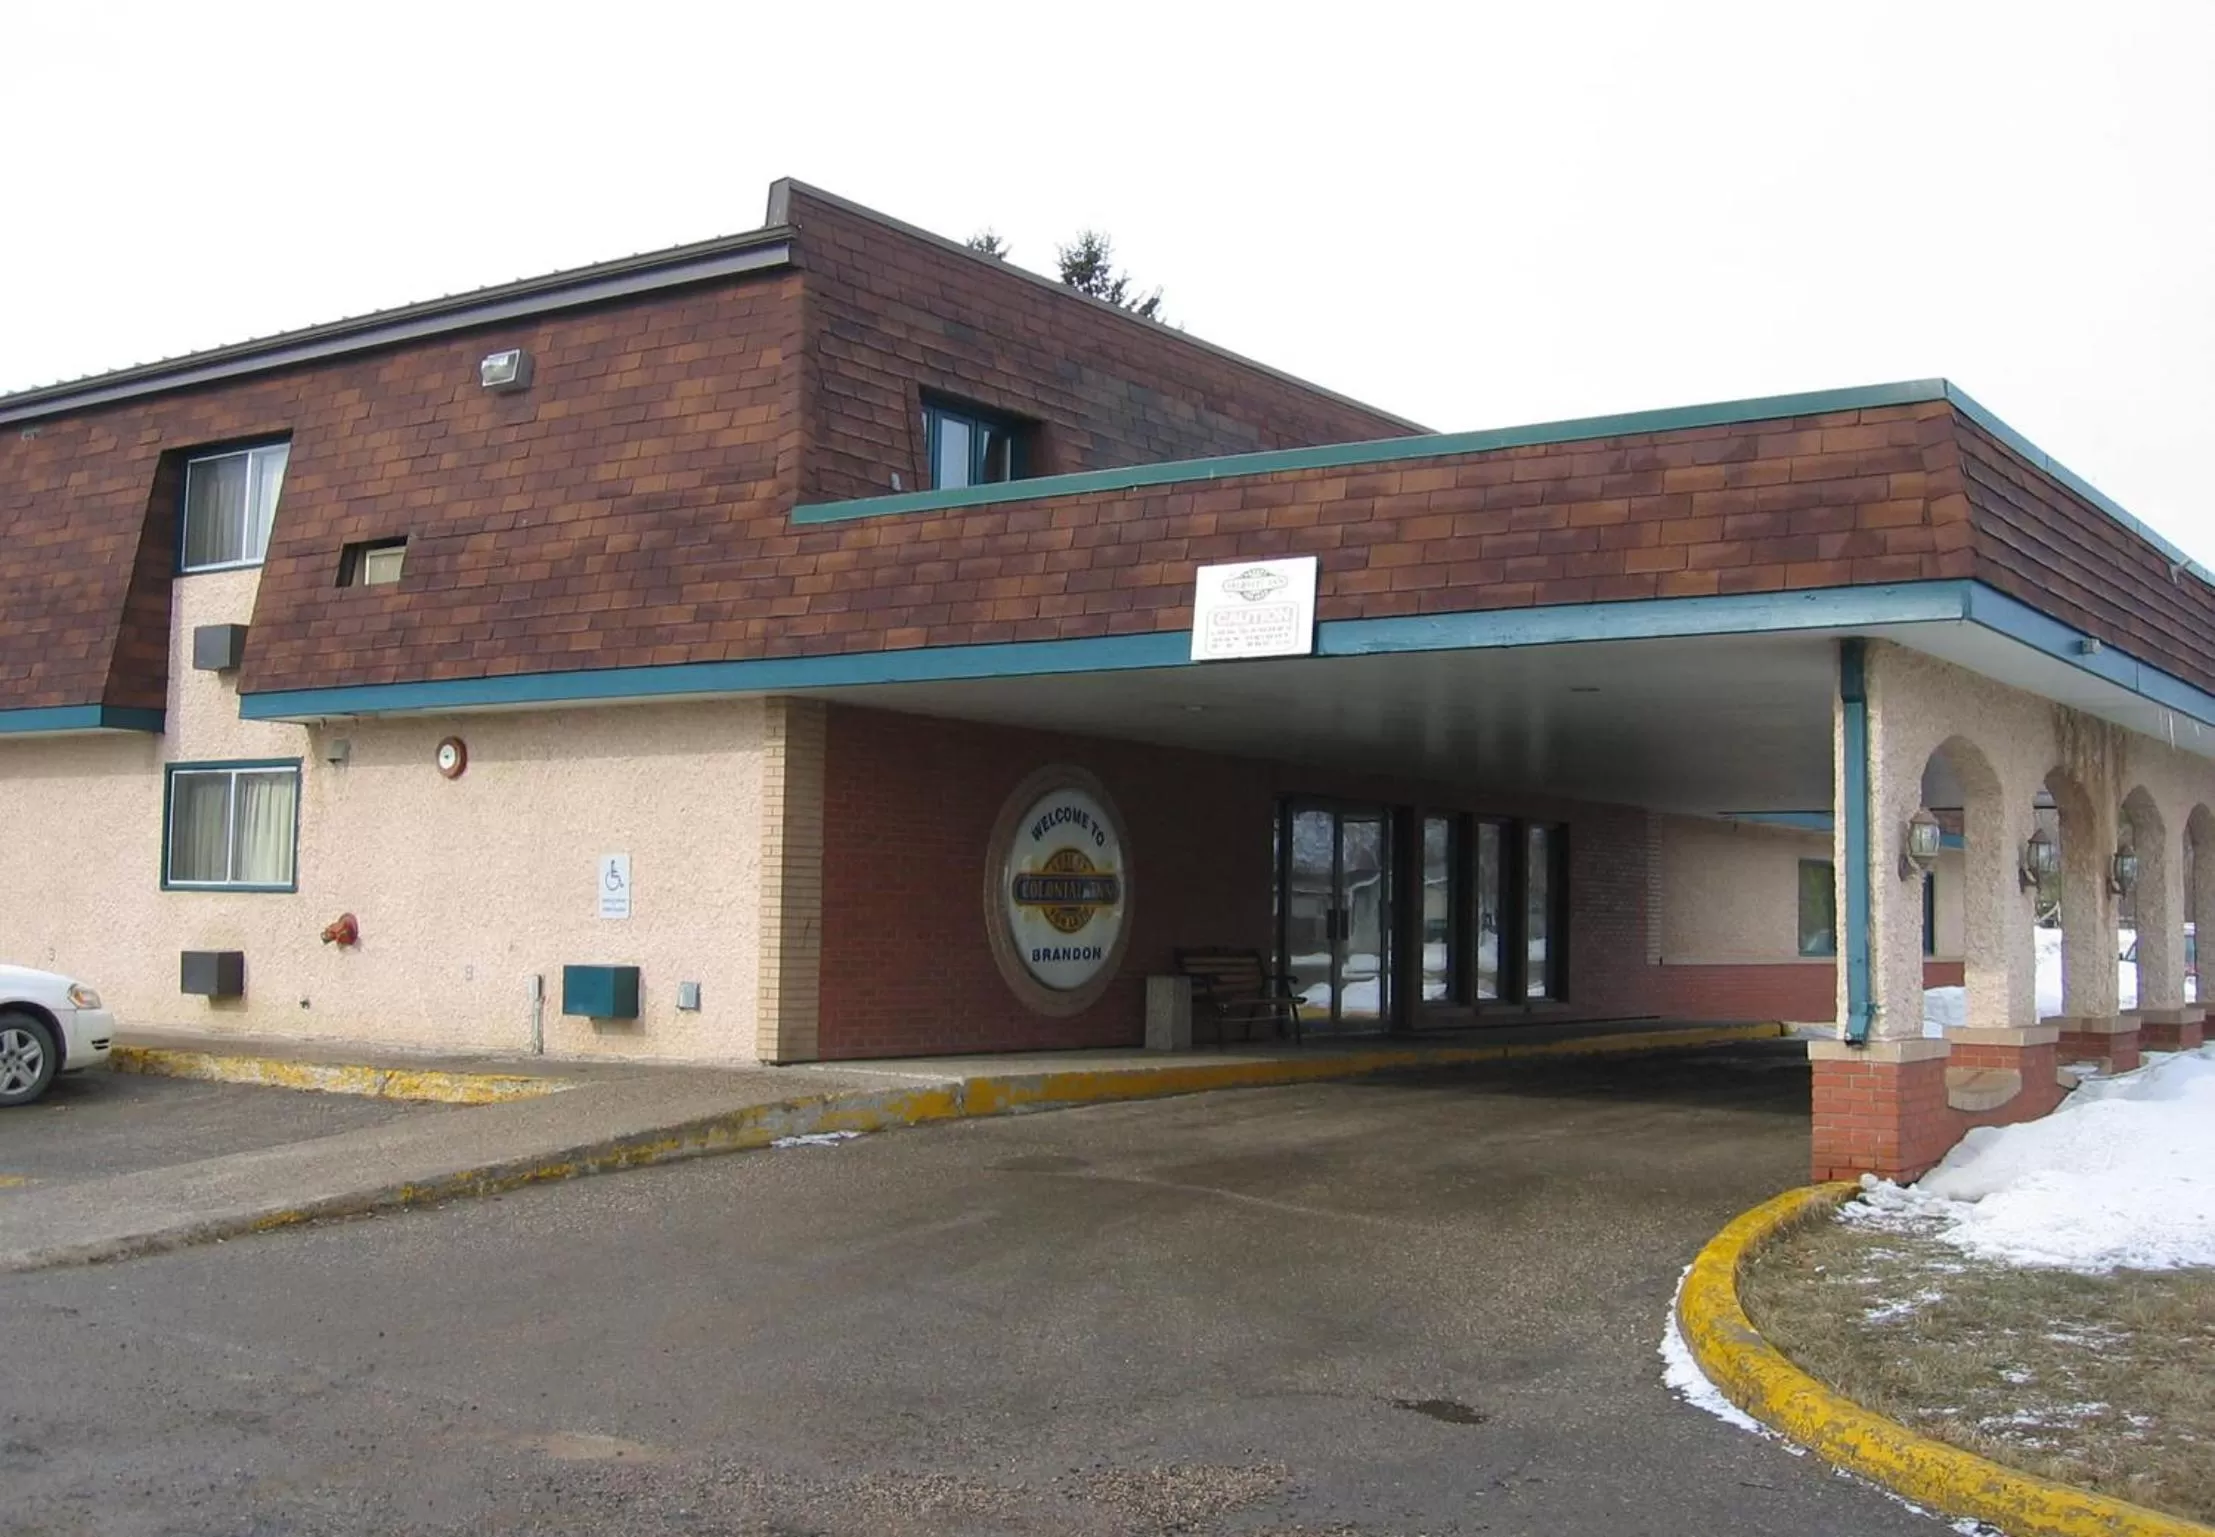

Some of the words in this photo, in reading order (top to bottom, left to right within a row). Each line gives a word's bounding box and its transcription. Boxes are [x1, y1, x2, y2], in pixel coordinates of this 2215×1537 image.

[1031, 807, 1089, 842] WELCOME
[1091, 819, 1105, 848] TO
[1031, 947, 1102, 963] BRANDON
